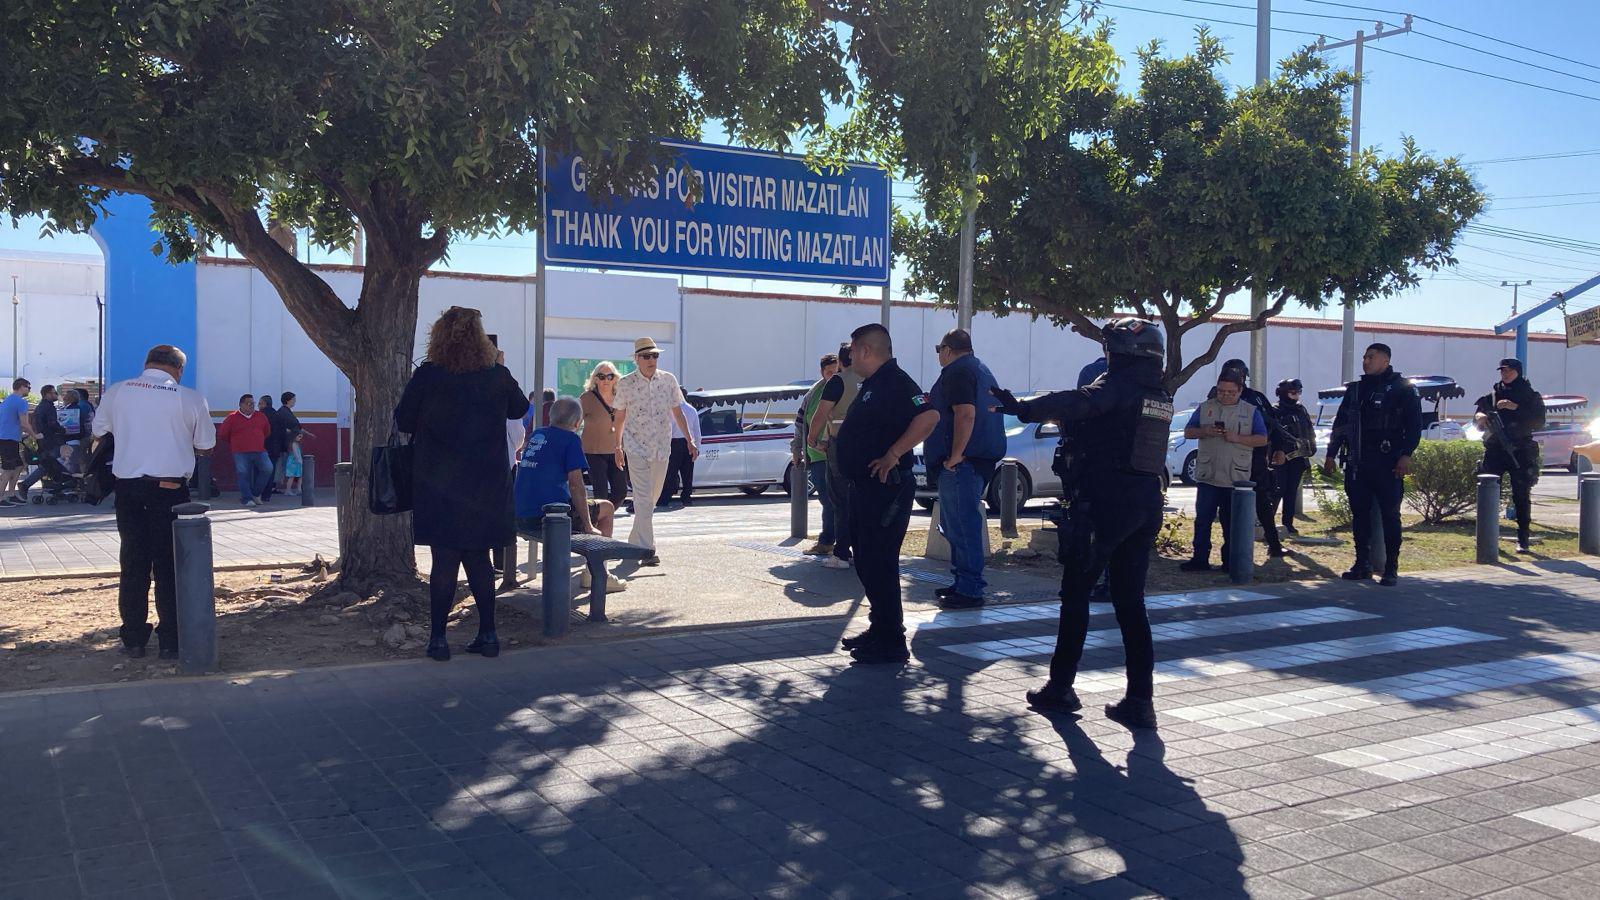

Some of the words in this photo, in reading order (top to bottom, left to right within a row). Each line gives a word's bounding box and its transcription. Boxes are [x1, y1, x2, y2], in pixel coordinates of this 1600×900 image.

[709, 171, 777, 211] VISITAR
[781, 177, 870, 219] MAZATLÁN
[552, 209, 623, 249] THANK
[631, 216, 670, 254] YOU
[675, 220, 713, 256] FOR
[717, 223, 792, 262] VISITING
[797, 230, 883, 269] MAZATLAN
